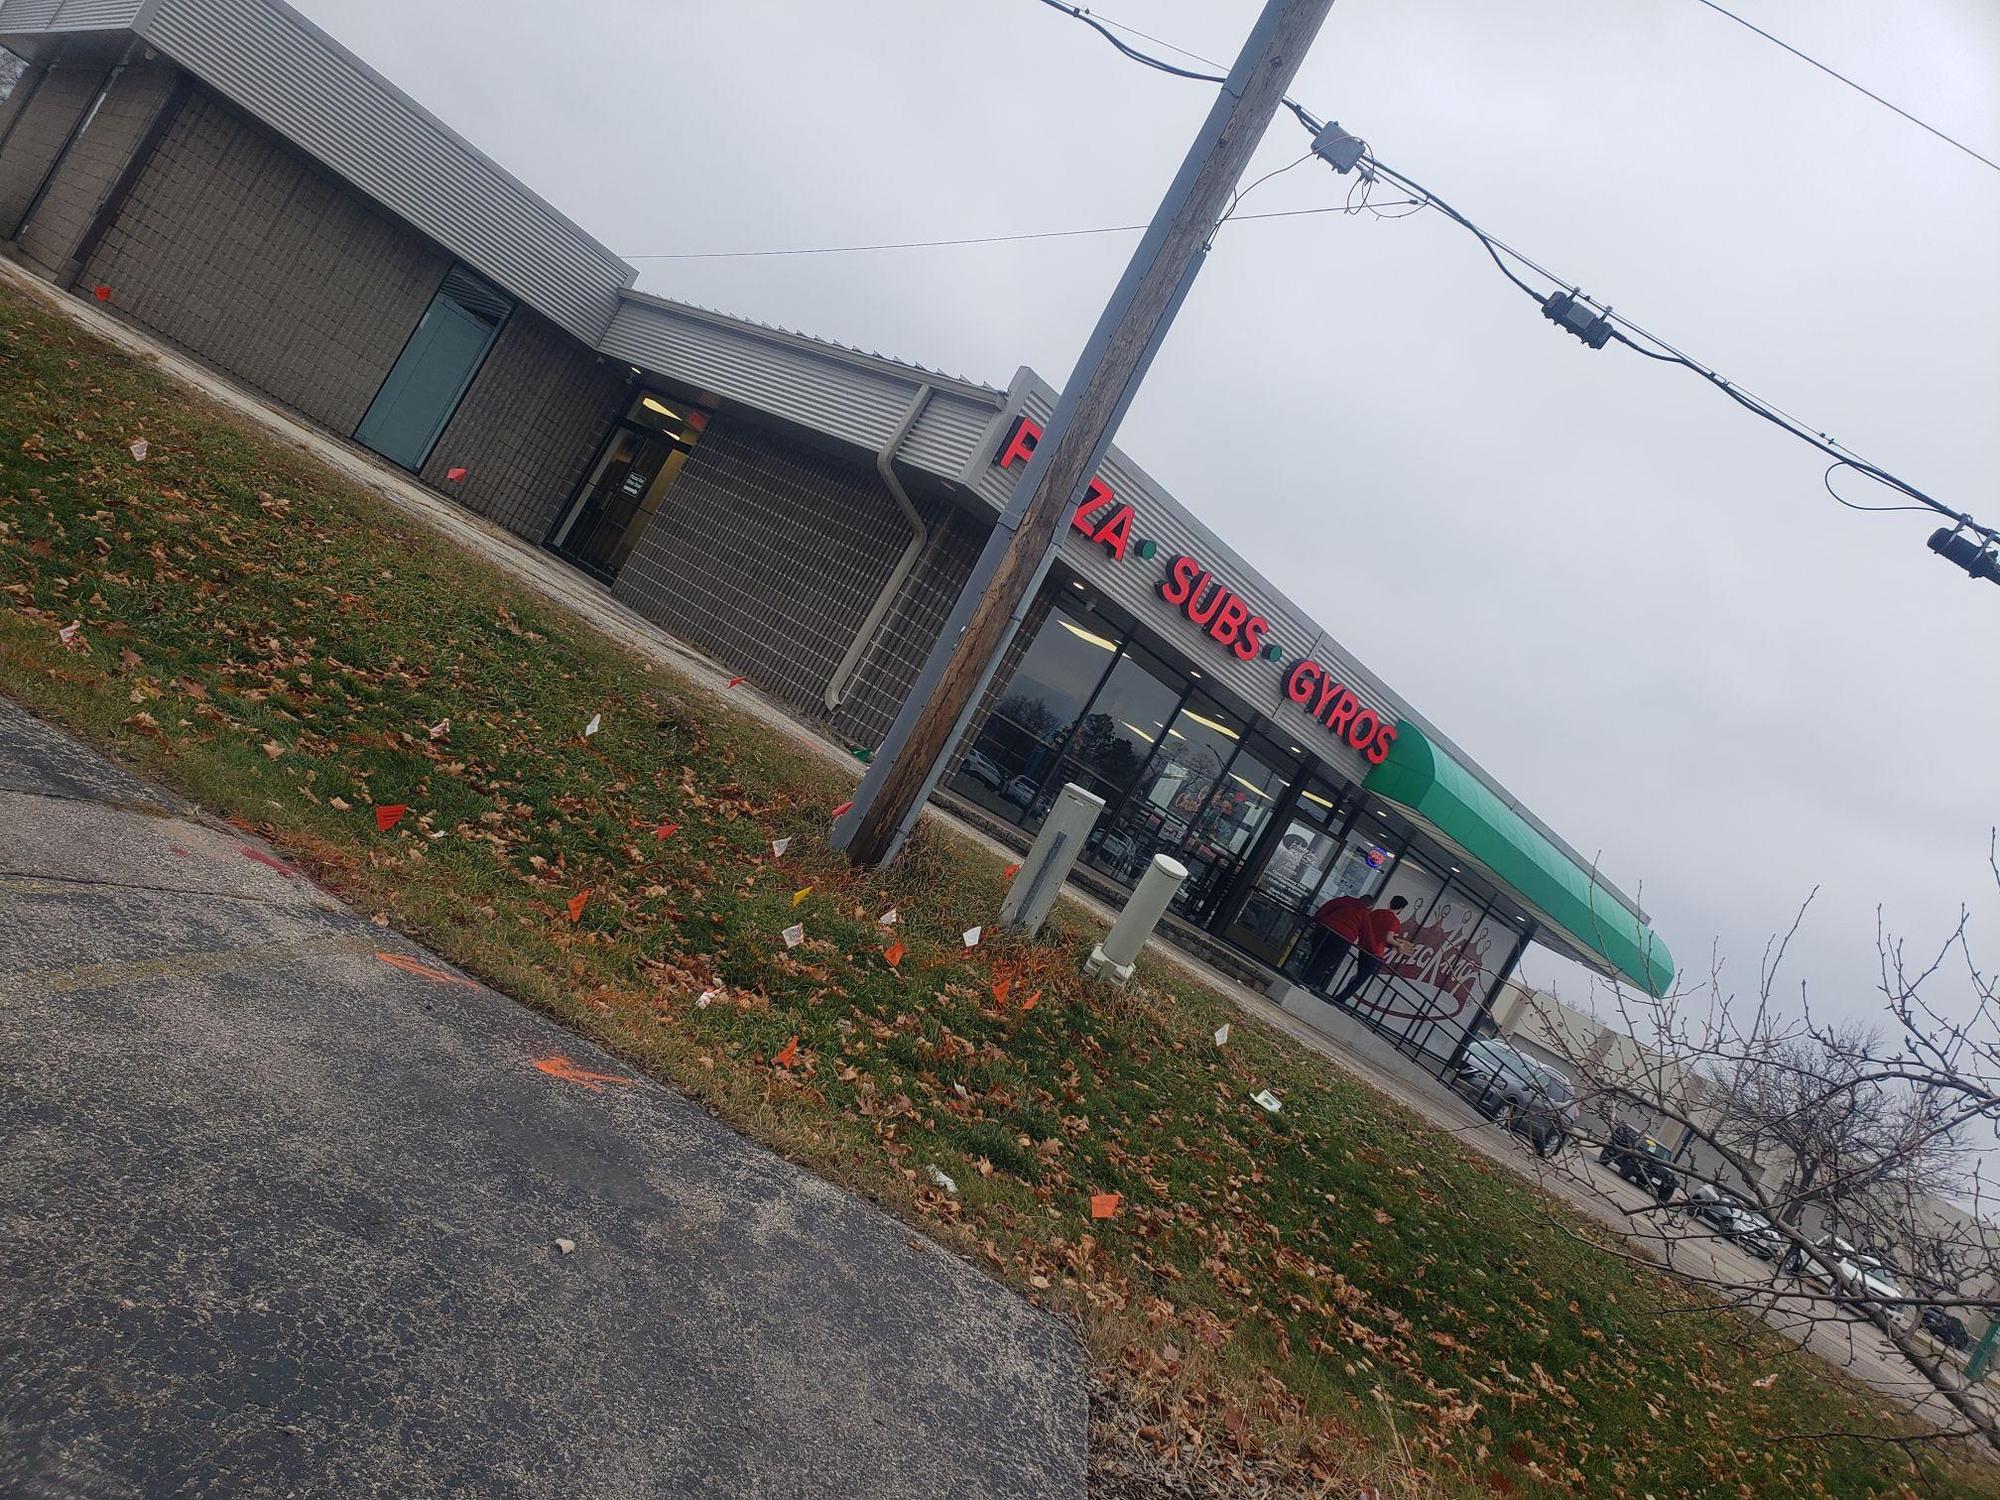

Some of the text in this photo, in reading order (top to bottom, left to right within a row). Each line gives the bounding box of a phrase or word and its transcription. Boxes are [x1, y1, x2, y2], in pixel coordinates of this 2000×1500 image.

[998, 415, 1398, 766] PZA SUBS GYROS
